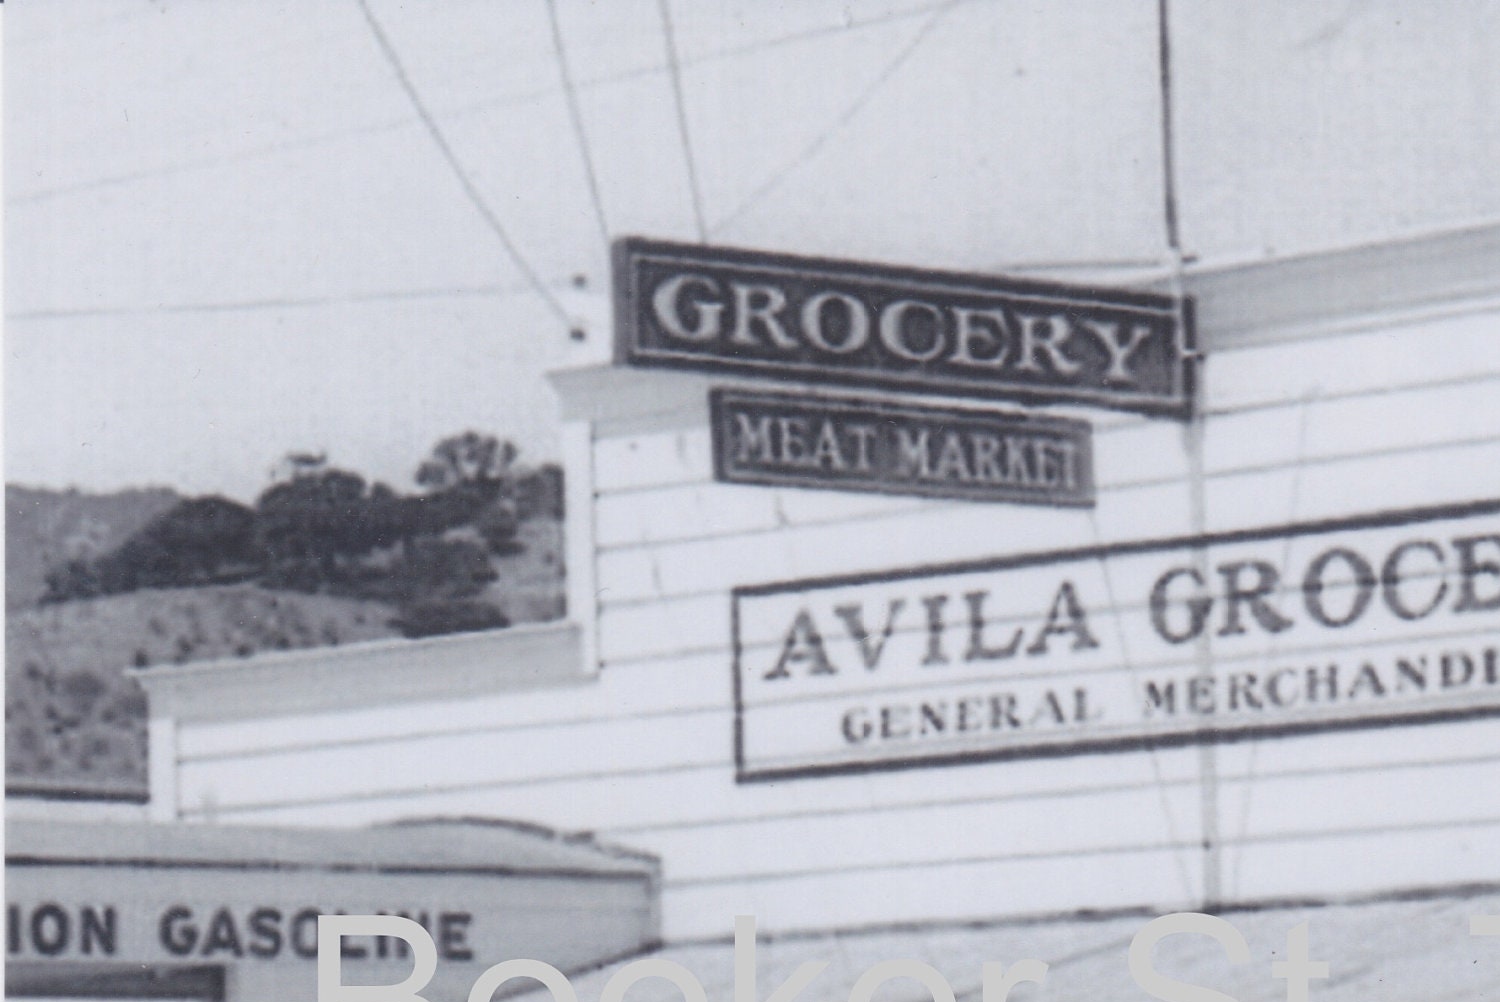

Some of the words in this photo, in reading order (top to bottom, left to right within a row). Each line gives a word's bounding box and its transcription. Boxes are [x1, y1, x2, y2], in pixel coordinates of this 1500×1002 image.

[652, 272, 1151, 384] GROCERY
[734, 412, 877, 470] MEAT
[896, 427, 1080, 491] MARKET
[762, 579, 1101, 682] AVILA
[840, 688, 1106, 747] GENERAL
[6, 902, 117, 957] ION
